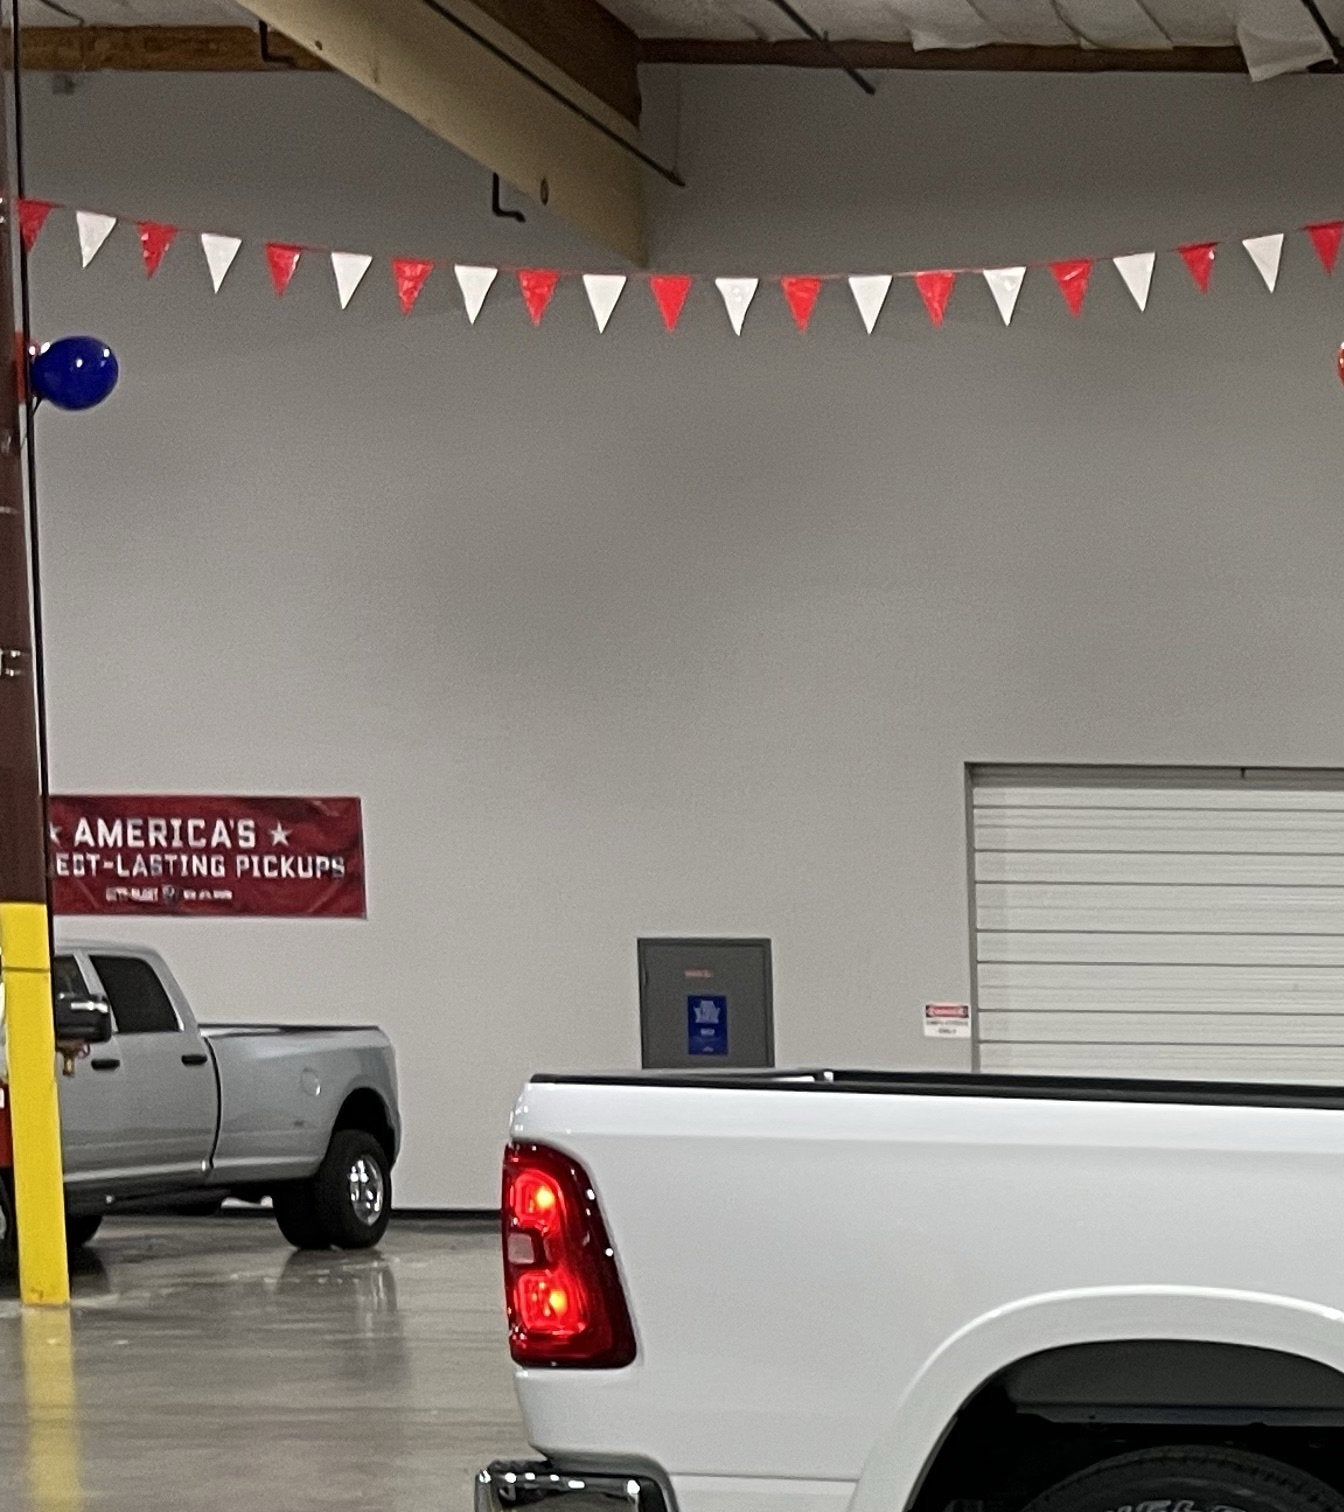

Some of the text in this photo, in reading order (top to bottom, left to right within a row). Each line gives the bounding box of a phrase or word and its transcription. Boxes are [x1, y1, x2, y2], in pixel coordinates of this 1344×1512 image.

[74, 816, 256, 848] AMERICA'S
[56, 852, 345, 879] EST-LASTING PICKUPS
